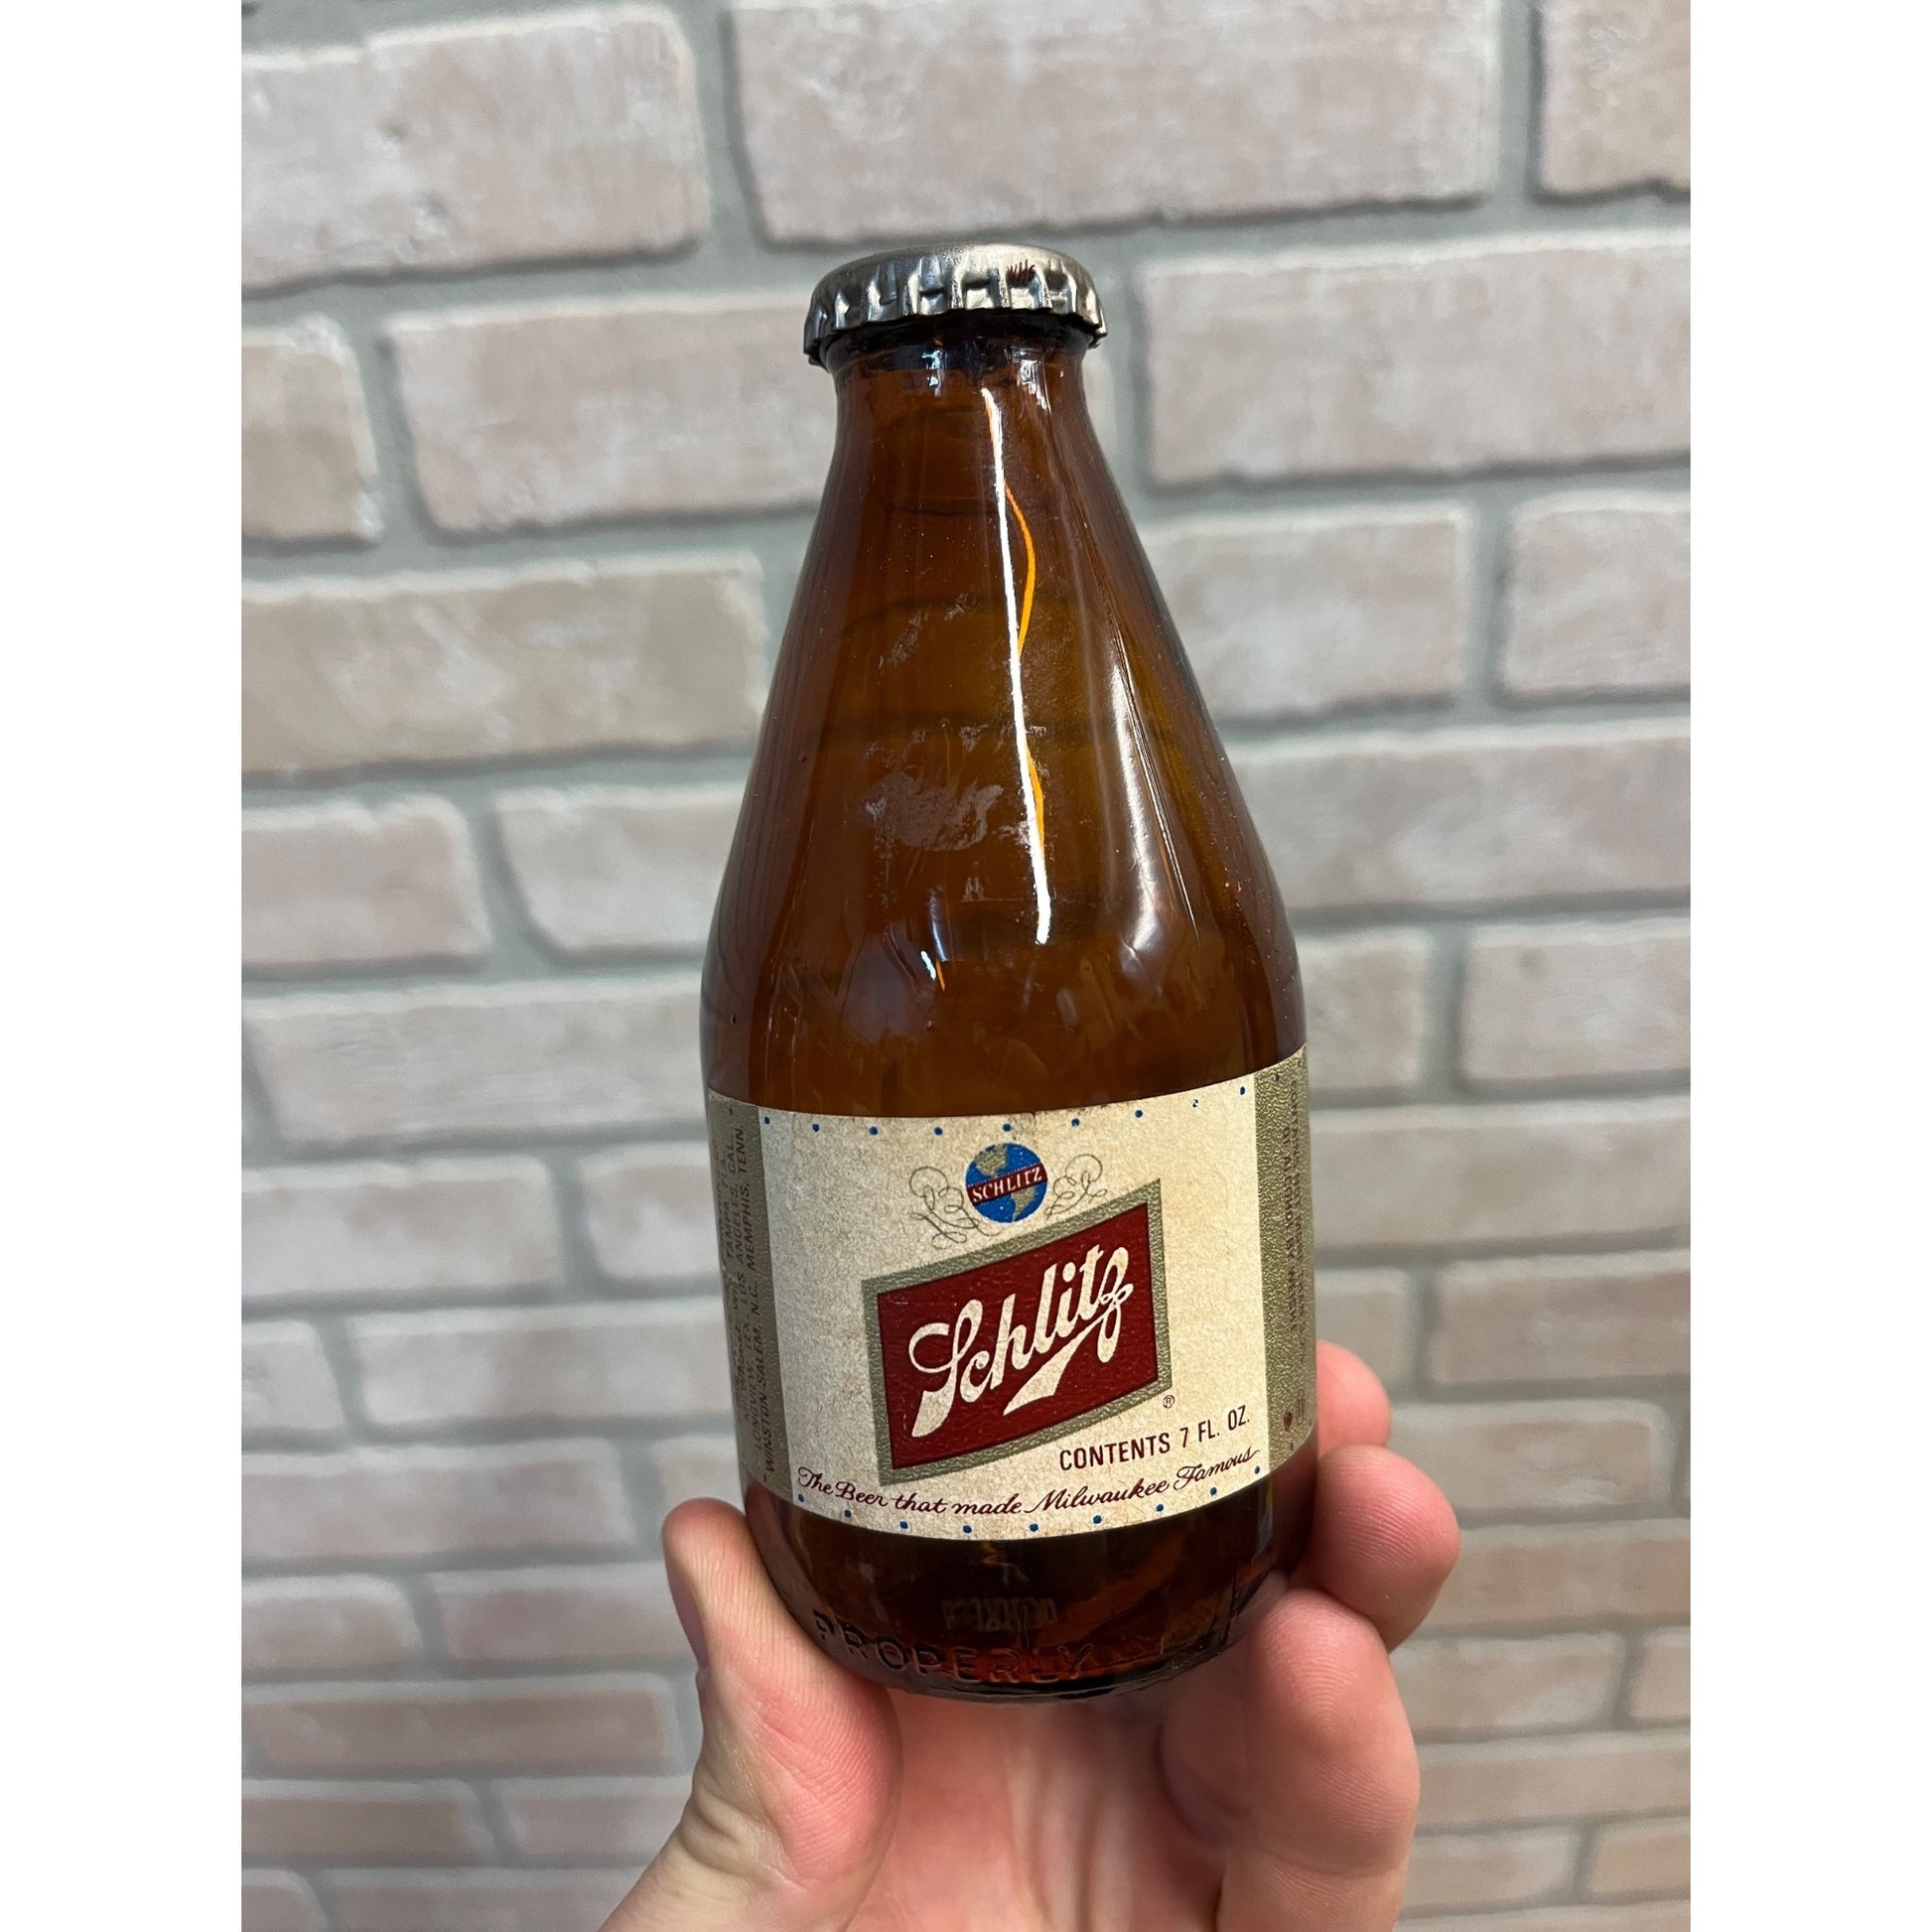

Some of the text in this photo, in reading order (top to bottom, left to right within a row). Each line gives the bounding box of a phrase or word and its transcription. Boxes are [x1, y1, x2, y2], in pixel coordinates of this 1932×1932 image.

[971, 1166, 1043, 1203] SCHLITZ
[737, 1272, 748, 1306] LOS
[907, 1243, 1135, 1439] Schlitz
[1059, 1404, 1250, 1471] CONTENTS 7 FL. OZ.
[797, 1445, 1261, 1515] The Beer that made Milwaukee Famous
[811, 1607, 1093, 1684] PROPERLY
